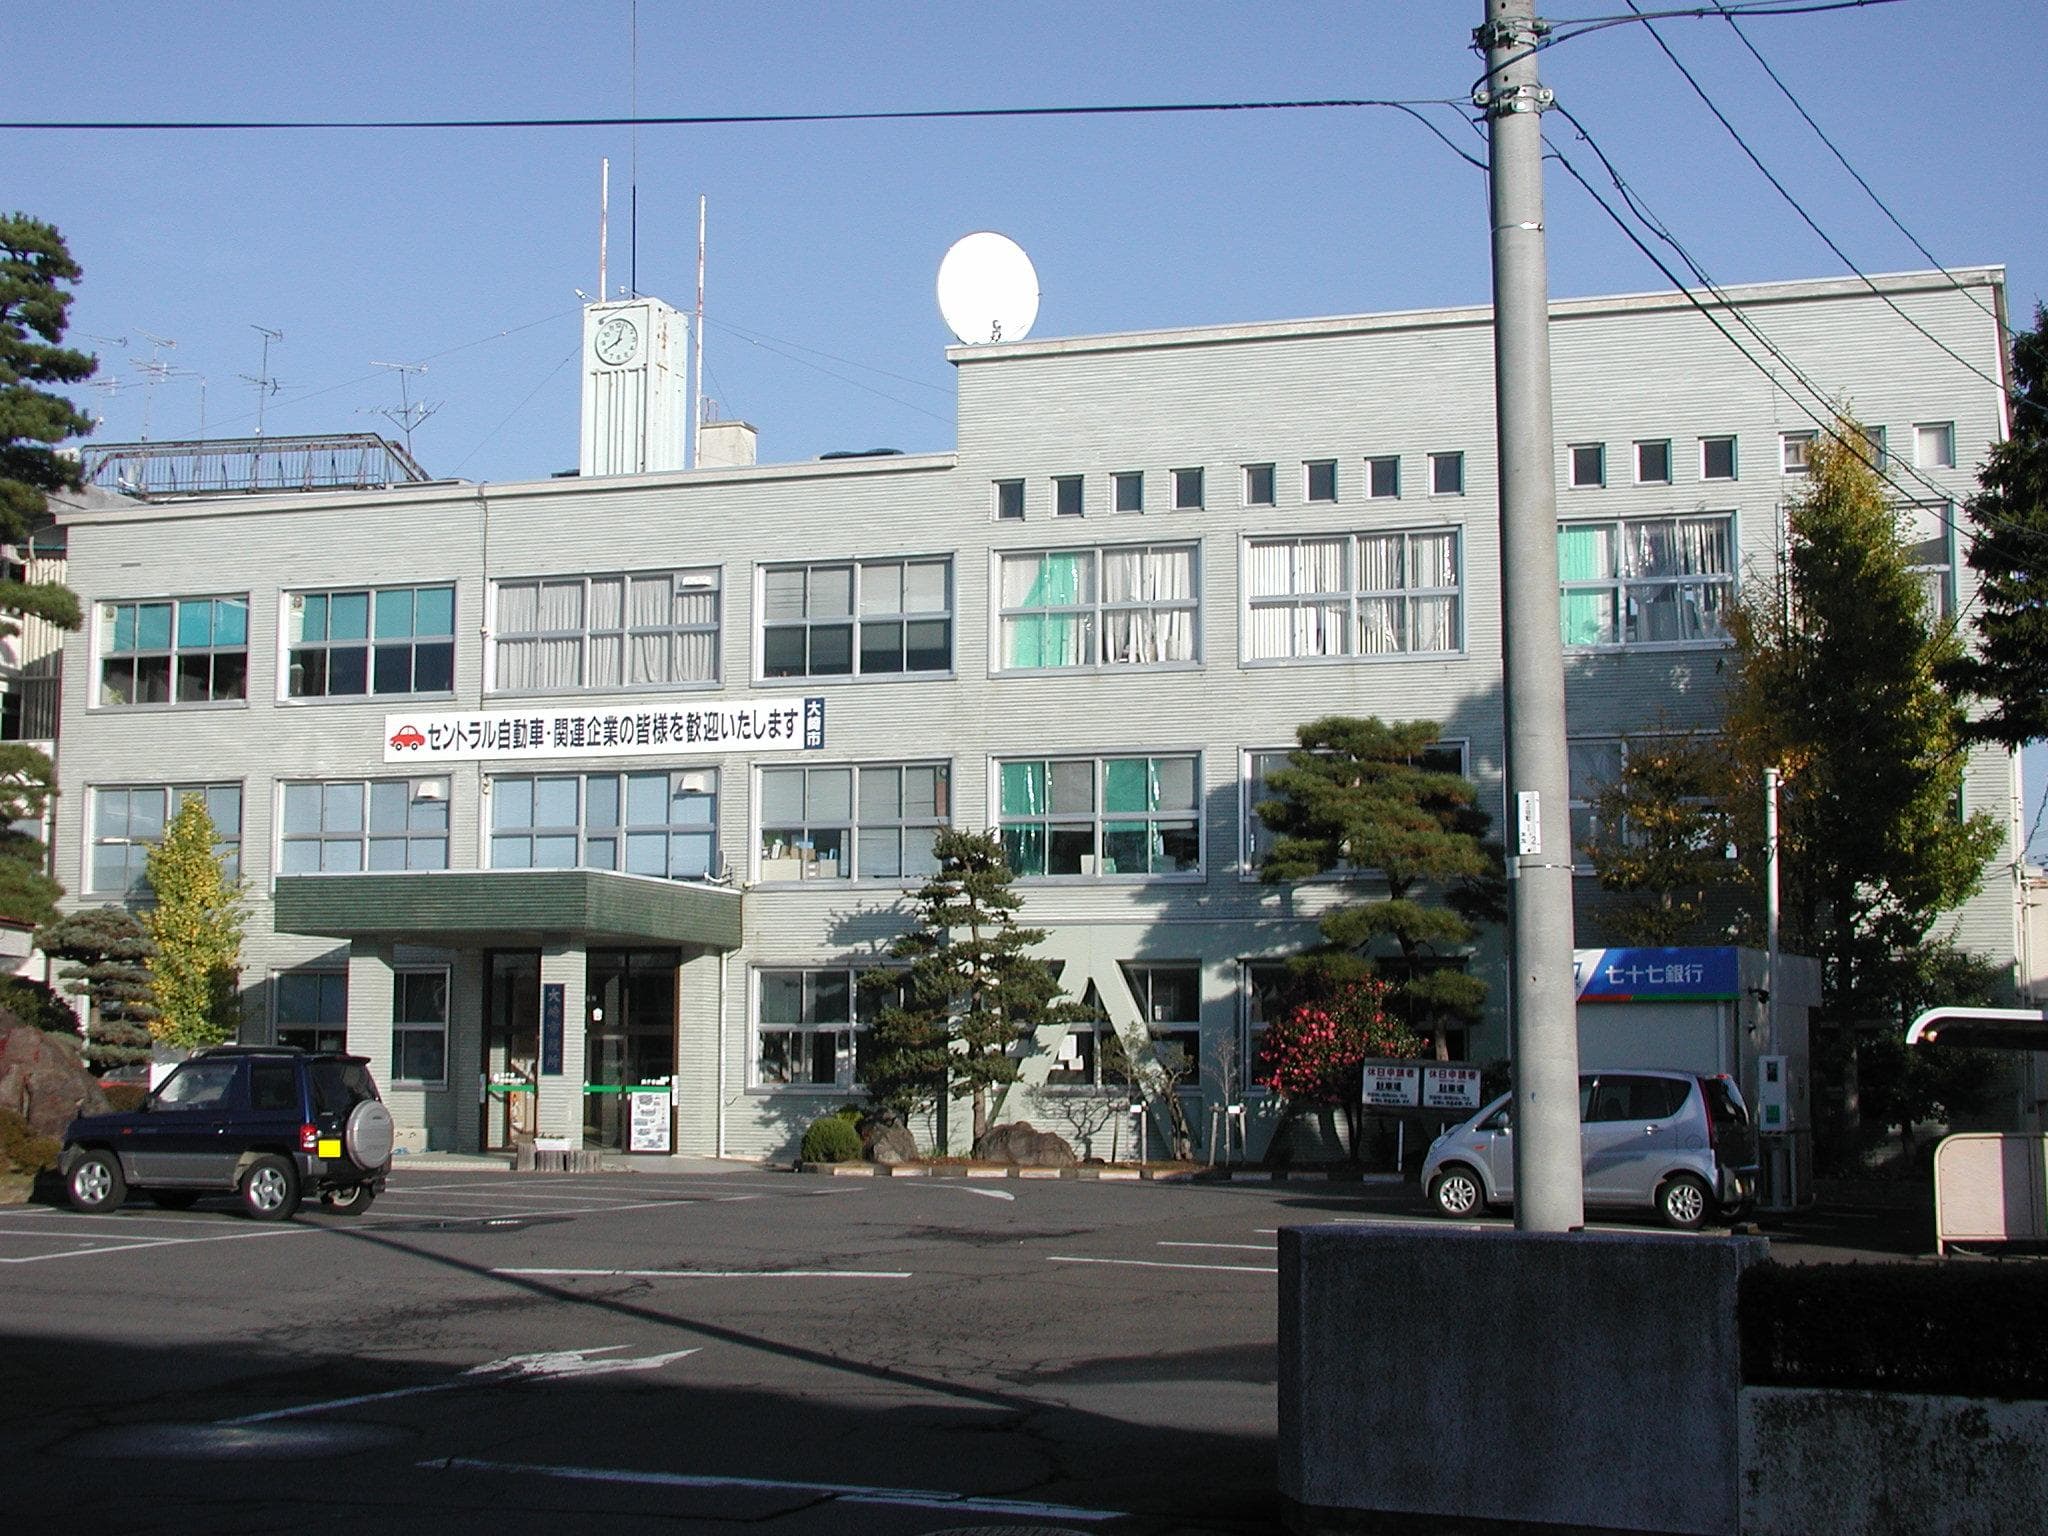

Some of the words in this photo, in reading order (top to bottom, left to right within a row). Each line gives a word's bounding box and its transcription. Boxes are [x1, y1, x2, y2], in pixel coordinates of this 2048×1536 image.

[428, 708, 799, 751] セントラル自動車・関連企業の皆様を歓迎いたします
[1605, 963, 1703, 984] 七十七銀行
